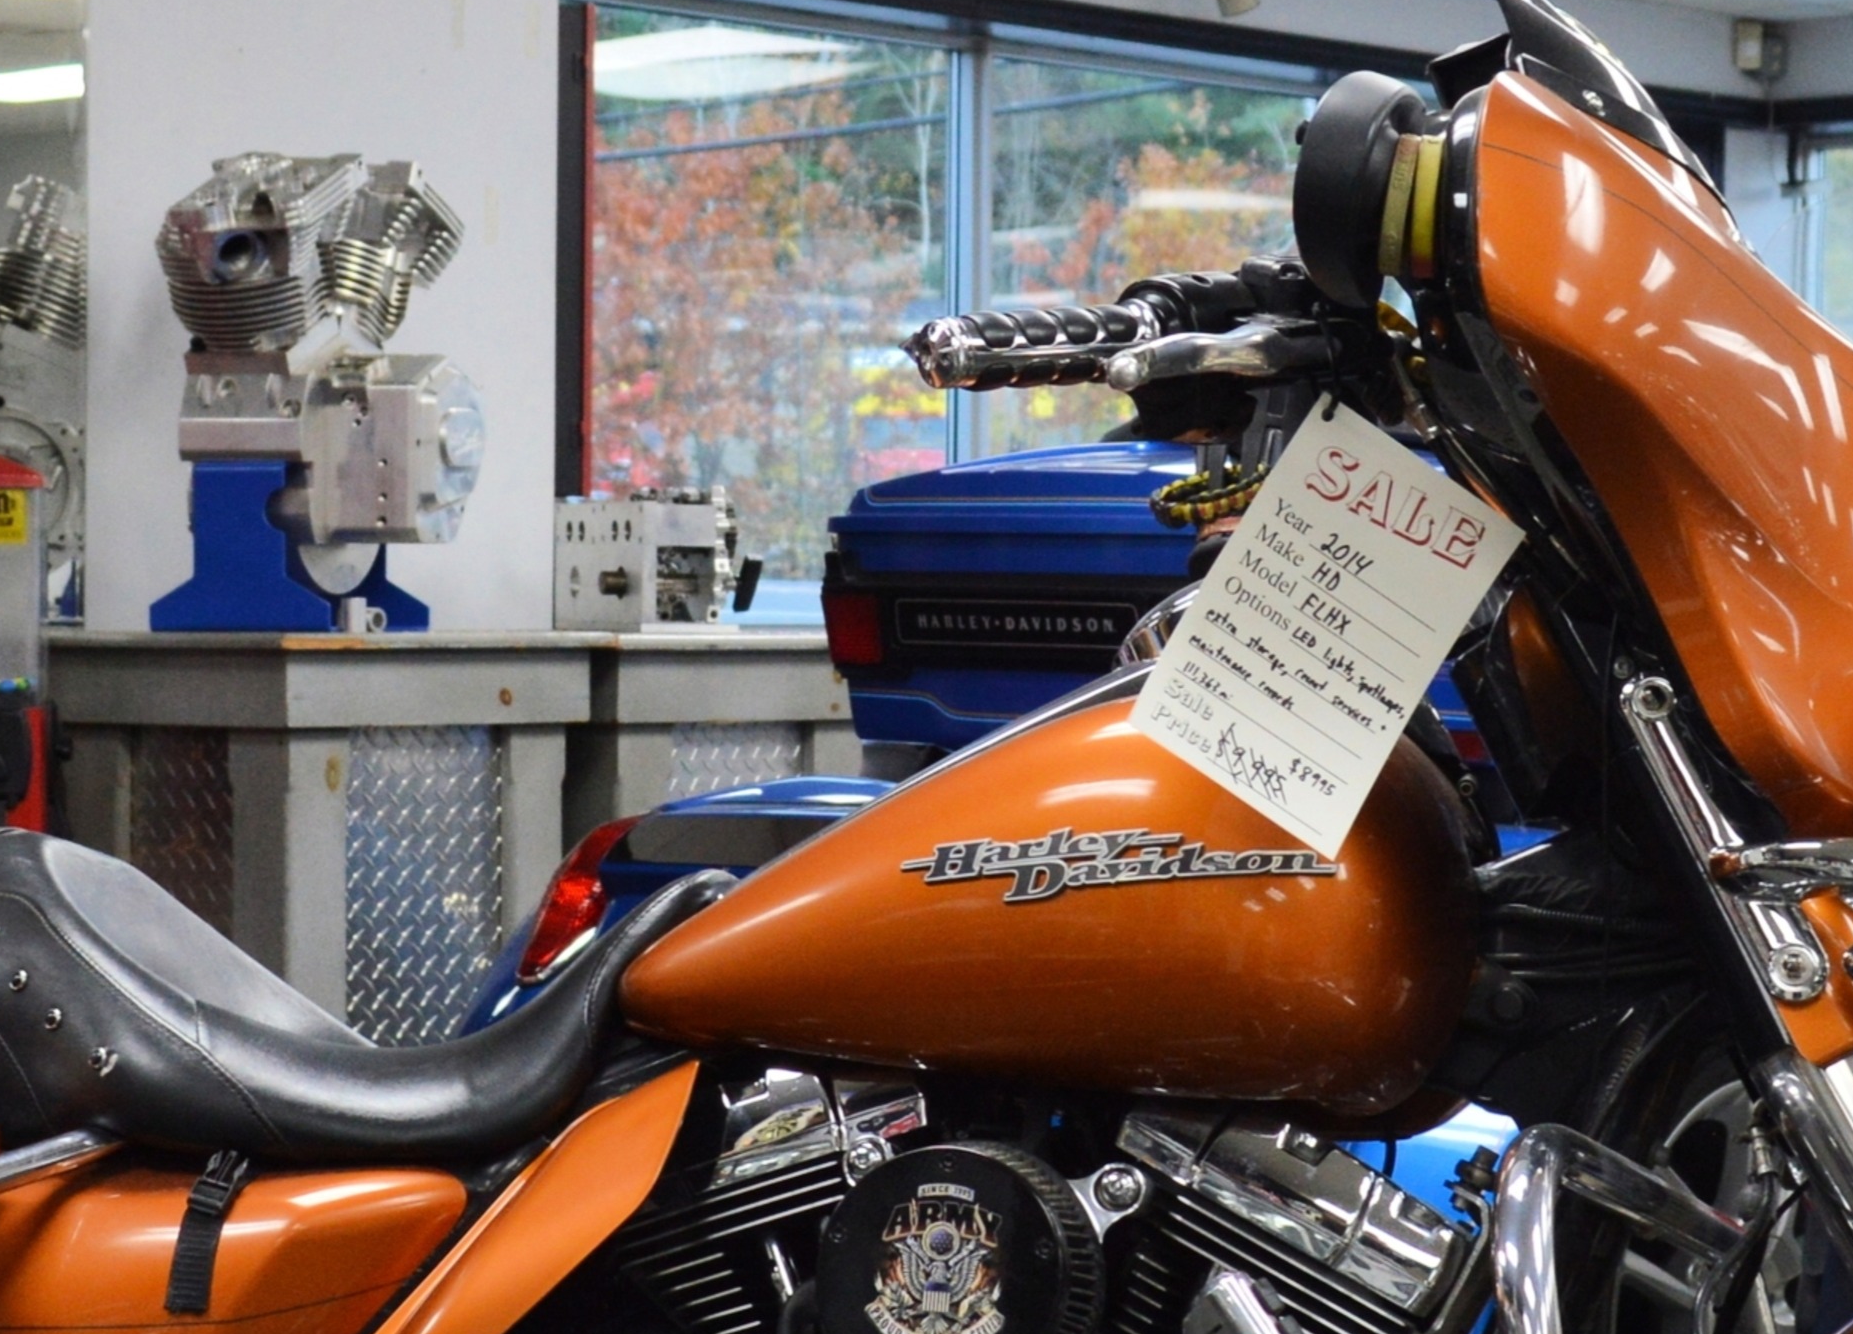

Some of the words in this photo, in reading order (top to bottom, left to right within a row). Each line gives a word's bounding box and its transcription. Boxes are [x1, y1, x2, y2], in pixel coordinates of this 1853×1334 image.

[1274, 497, 1314, 536] Year
[1320, 533, 1375, 577] 2014
[1304, 446, 1486, 570] SALE
[1254, 523, 1304, 567] Make
[1311, 561, 1341, 592] HD
[1205, 607, 1238, 636] extra
[1224, 575, 1291, 632] Options
[1291, 625, 1317, 648] LED
[1239, 549, 1299, 598] Model
[1300, 592, 1352, 636] FLHX
[1151, 702, 1212, 754] Price
[1164, 678, 1214, 721] Sale
[1288, 757, 1337, 797] $8995
[901, 827, 1182, 883] Harley
[988, 842, 1338, 904] Davidson
[882, 1198, 1003, 1248] ARMY
